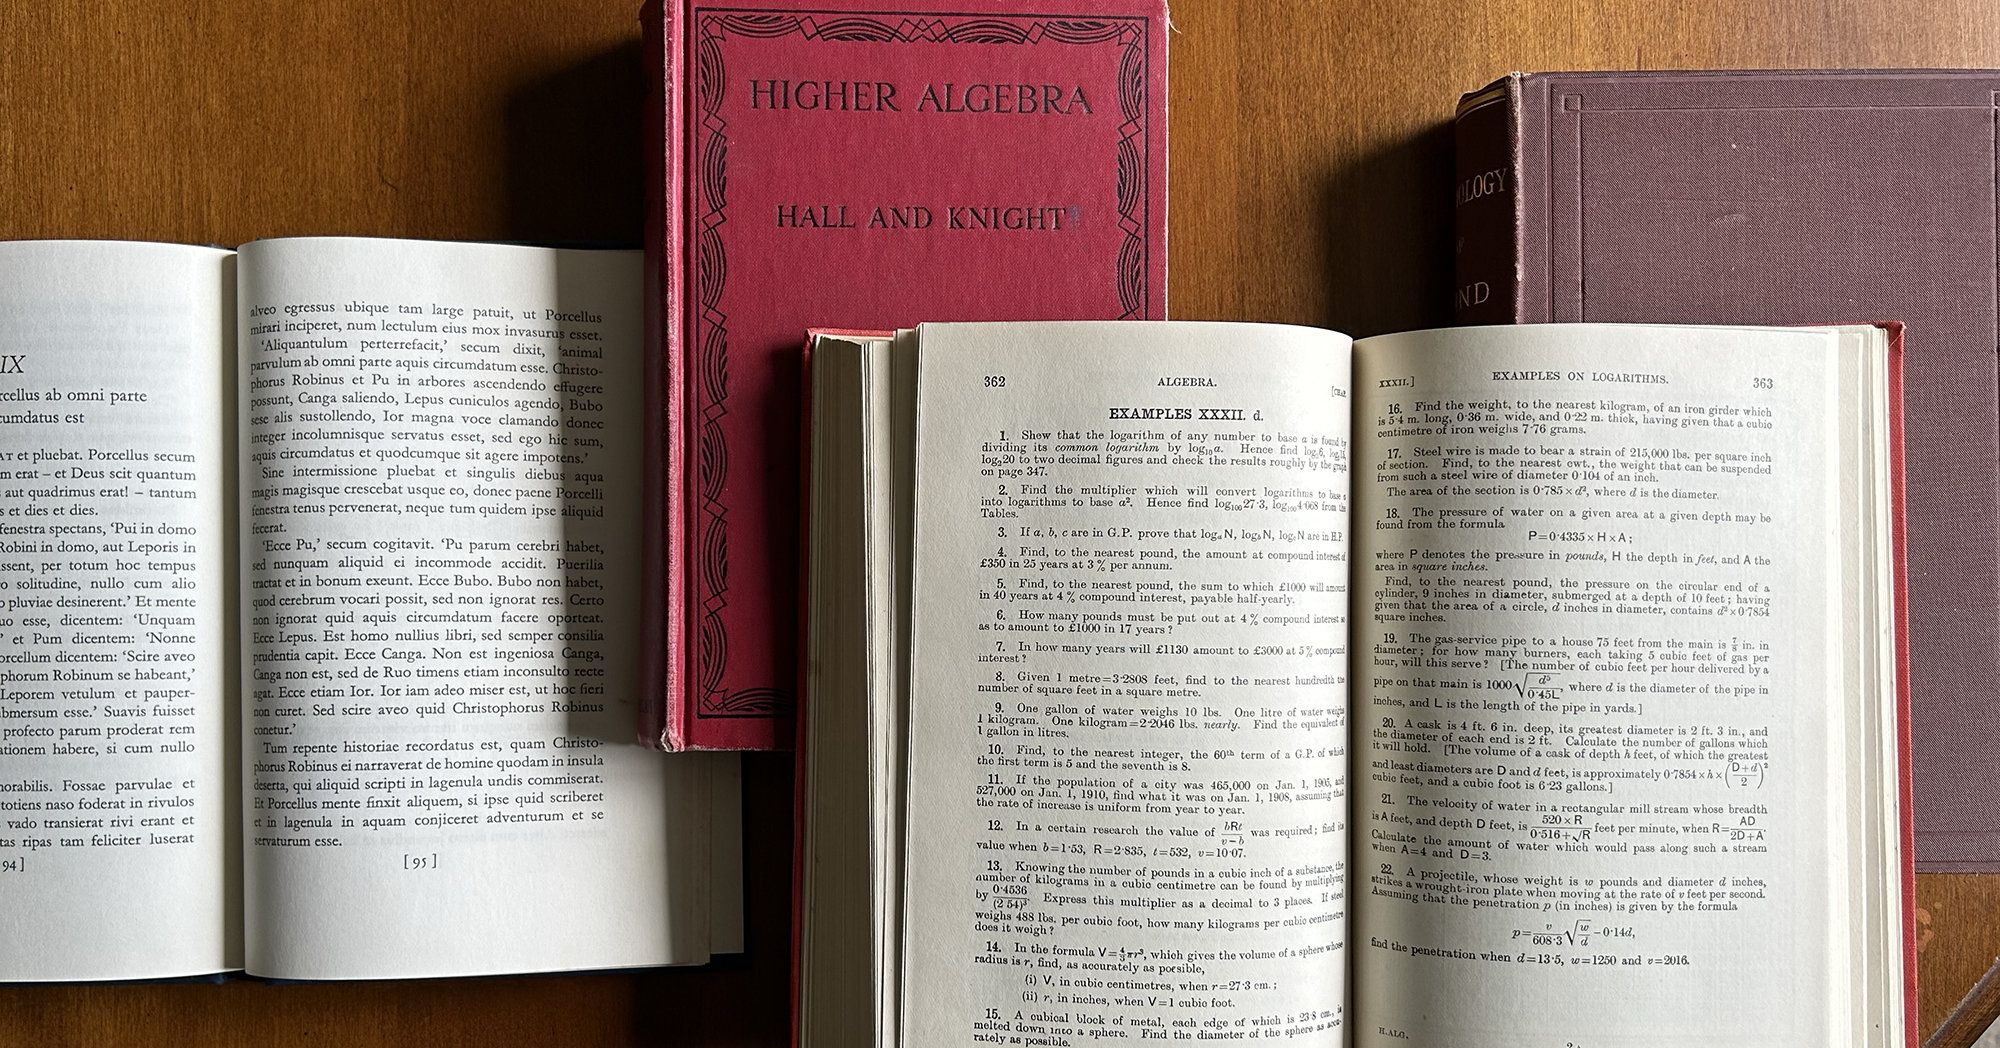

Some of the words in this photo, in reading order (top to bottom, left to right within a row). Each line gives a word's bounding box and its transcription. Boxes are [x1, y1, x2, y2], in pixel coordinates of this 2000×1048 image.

[749, 79, 901, 112] HIGHER
[917, 83, 1093, 116] ALGEBRA
[1456, 167, 1508, 208] OLOGY
[777, 205, 855, 229] HALL
[868, 205, 933, 230] AND
[948, 206, 1066, 231] KNIGHT
[250, 305, 277, 318] alveo
[284, 303, 336, 316] egressus
[344, 300, 389, 317] ubique
[398, 304, 423, 314] tam
[432, 303, 464, 319] large
[473, 306, 514, 321] patuit,
[523, 311, 536, 320] ut
[545, 309, 603, 326] Porcellus
[460, 344, 500, 353] secum
[512, 342, 545, 358] dixit,
[0, 355, 26, 374] IX
[984, 376, 1006, 388] 362
[1157, 377, 1217, 387] ALGEBRA.
[1492, 371, 1561, 381] EXAMPLES
[1567, 371, 1585, 381] ON
[1592, 372, 1669, 384] LOGARITHMS.
[1753, 377, 1773, 389] 363
[45, 387, 62, 401] ab
[67, 388, 105, 401] omni
[110, 392, 147, 406] parte
[65, 413, 85, 424] est
[1109, 408, 1192, 420] EXAMPLES
[1198, 408, 1246, 421] XXXII.
[17, 451, 29, 461] et
[32, 448, 83, 464] pluebat.
[88, 448, 149, 461] Porcellus
[154, 453, 195, 462] secum
[15, 470, 39, 479] erat
[54, 469, 67, 479] et
[71, 467, 105, 479] Deus
[109, 467, 132, 479] scit
[136, 471, 196, 483] quantum
[262, 467, 285, 479] Sine
[292, 464, 378, 477] intermissione
[387, 464, 435, 480] pluebat
[445, 468, 457, 477] et
[467, 466, 515, 482] singulis
[525, 467, 566, 481] diebus
[574, 472, 604, 485] aqua
[998, 469, 1023, 479] page
[1026, 466, 1048, 477] 347.
[980, 508, 1019, 519] Tables.
[252, 522, 287, 535] fecerat.
[1376, 519, 1404, 530] found
[1407, 519, 1435, 529] from
[1437, 519, 1456, 529] the
[1459, 519, 1506, 529] formula
[326, 541, 367, 550] secum
[373, 537, 434, 553] cogitavit.
[469, 542, 511, 554] parum
[516, 539, 560, 552] cerebri
[566, 540, 604, 555] habet,
[1374, 614, 1406, 624] square
[1409, 612, 1446, 622] inches.
[978, 682, 1019, 693] number
[1022, 683, 1034, 693] of
[1037, 686, 1073, 697] square
[1076, 684, 1098, 695] feet
[1101, 685, 1112, 695] in
[1126, 689, 1163, 699] square
[1166, 688, 1201, 697] metre.
[1373, 695, 1405, 708] inches,
[1409, 697, 1430, 708] and
[1434, 698, 1443, 708] L
[1446, 698, 1456, 709] is
[1460, 699, 1479, 710] the
[1483, 699, 1520, 713] length
[1524, 701, 1536, 711] of
[1540, 701, 1558, 712] the
[1562, 702, 1586, 715] pipe
[1590, 702, 1601, 712] in
[3, 724, 54, 741] profecto
[59, 727, 102, 740] parum
[106, 723, 164, 740] proderat
[169, 726, 195, 734] rem
[262, 741, 288, 754] Tum
[292, 744, 338, 757] repente
[343, 740, 400, 753] historiae
[405, 739, 474, 752] recordatus
[480, 741, 502, 752] est,
[510, 741, 546, 753] quam
[553, 736, 605, 749] Christo-
[62, 779, 106, 792] Fossae
[115, 778, 173, 795] parvulae
[182, 779, 195, 789] et
[976, 797, 994, 807] the
[997, 799, 1019, 808] rate
[1022, 798, 1034, 809] of
[1037, 799, 1081, 811] increase
[1085, 801, 1094, 811] is
[1097, 802, 1141, 813] uniform
[1146, 803, 1172, 813] from
[1175, 806, 1200, 817] year
[1204, 805, 1215, 814] to
[1218, 807, 1245, 817] year.
[1381, 793, 1395, 805] 21.
[1406, 795, 1428, 807] The
[1432, 797, 1478, 812] velocity
[1481, 800, 1494, 810] of
[1497, 802, 1531, 812] water
[1535, 802, 1547, 812] in
[1561, 803, 1625, 816] rectangular
[1629, 803, 1650, 814] mill
[1654, 805, 1689, 814] stream
[1693, 804, 1724, 814] whose
[1728, 803, 1768, 814] breadth
[254, 818, 262, 828] et
[265, 815, 277, 828] in
[284, 815, 333, 832] lagenula
[341, 815, 355, 828] in
[362, 818, 406, 831] aquam
[414, 813, 479, 829] conjiceret
[486, 811, 564, 823] adventurum
[571, 811, 584, 821] et
[591, 811, 604, 820] se
[22, 835, 52, 851] ripas
[60, 838, 85, 847] tam
[91, 834, 142, 847] feliciter
[149, 833, 194, 845] luserat
[254, 837, 311, 847] servaturum
[314, 838, 342, 847] esse.
[1371, 936, 1388, 949] find
[1391, 941, 1408, 952] the
[1411, 944, 1477, 960] penetration
[1480, 951, 1511, 962] when
[1621, 955, 1642, 966] and
[973, 1032, 1006, 1045] rately
[1009, 1036, 1021, 1044] as
[1025, 1036, 1071, 1048] possible.
